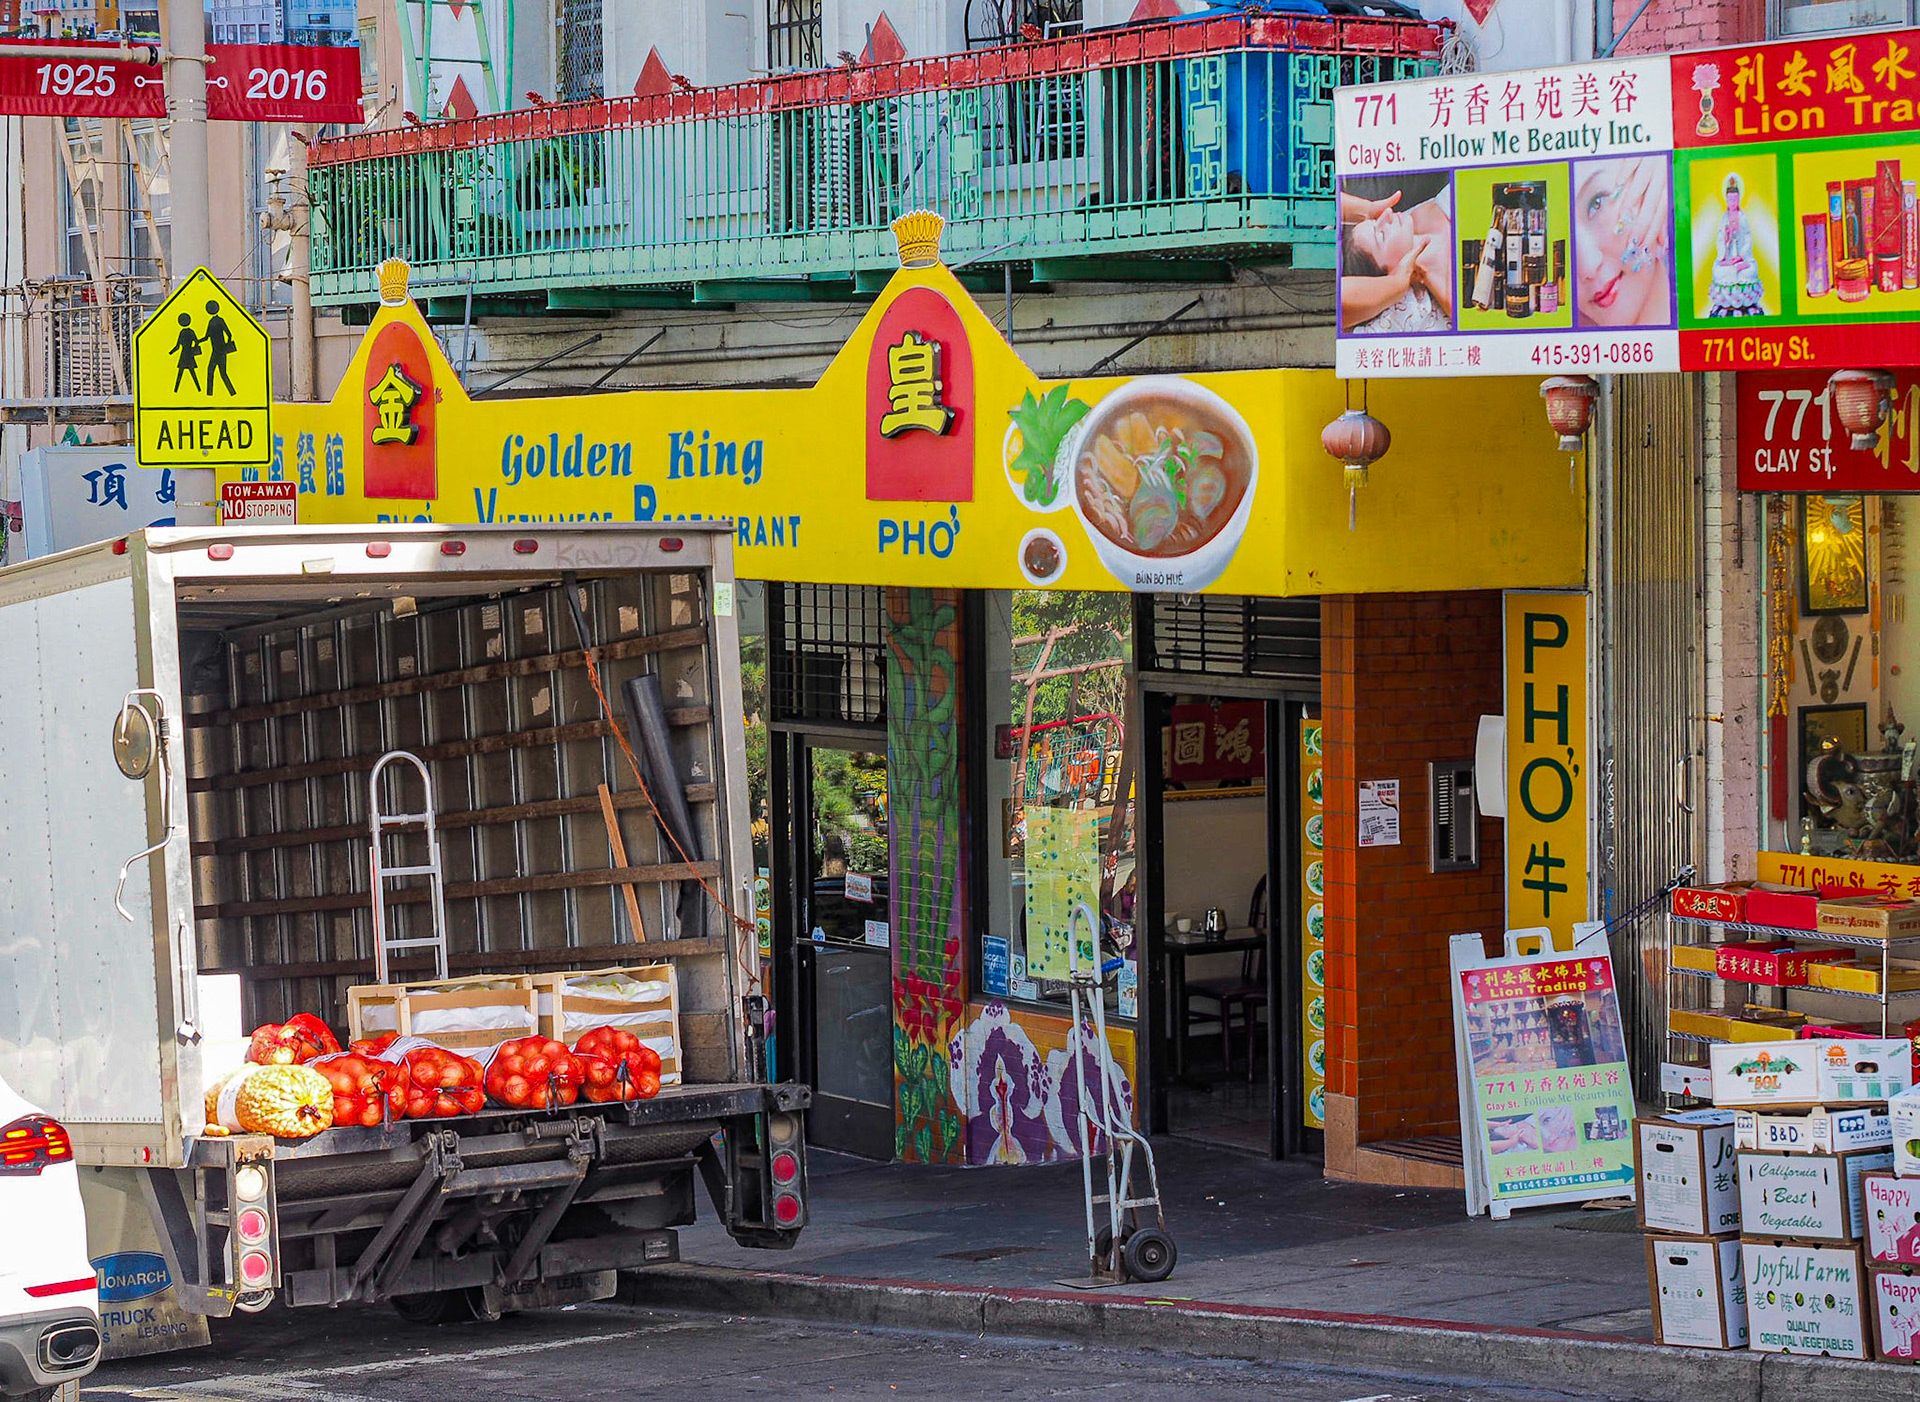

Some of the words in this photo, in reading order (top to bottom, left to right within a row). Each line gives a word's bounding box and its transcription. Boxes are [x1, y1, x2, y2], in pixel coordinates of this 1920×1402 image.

[36, 63, 117, 97] 1925
[246, 67, 328, 101] 2016
[1354, 93, 1397, 128] 771
[1428, 70, 1638, 129] 芳香名苑美容
[1734, 105, 1825, 136] Lion
[1419, 134, 1486, 160] Follow
[1492, 131, 1520, 154] Me
[1527, 124, 1602, 153] Beauty
[1608, 120, 1651, 145] Inc.
[1349, 143, 1381, 169] Clay
[1385, 141, 1406, 163] St.
[1531, 343, 1654, 365] 415-391-0886
[1703, 338, 1735, 362] 771
[1741, 337, 1783, 367] Clay
[1789, 335, 1816, 361] St.
[879, 329, 956, 438] 皇
[368, 363, 422, 446] 金
[1758, 389, 1831, 441] 771
[156, 419, 254, 450] AHEAD
[501, 432, 633, 486] Golden
[668, 429, 764, 485] King
[1755, 448, 1800, 472] CLAY
[1809, 448, 1837, 472] ST.
[226, 485, 292, 497] TOW-AWAY
[223, 500, 244, 519] NO
[246, 502, 292, 517] STOPPING
[1779, 864, 1805, 886] 771
[1490, 988, 1524, 998] Lion
[1527, 981, 1588, 994] Trading
[1485, 1081, 1516, 1095] 771
[1524, 1096, 1556, 1107] Follow
[1558, 1094, 1572, 1103] Me
[1574, 1090, 1606, 1102] Beauty
[1486, 1103, 1506, 1112] Clay
[1759, 1163, 1818, 1181] California
[1773, 1187, 1807, 1205] Best
[1870, 1181, 1911, 1207] Happy
[1760, 1213, 1823, 1230] Vegetables
[1752, 1255, 1800, 1287] Joyful
[1805, 1257, 1851, 1283] Farm
[100, 1307, 156, 1328] TRUCK
[1786, 1320, 1821, 1333] QUALITY
[137, 1322, 188, 1339] LEASING
[1760, 1333, 1798, 1347] ORIENTAL
[1799, 1336, 1854, 1352] VEGETABLES
